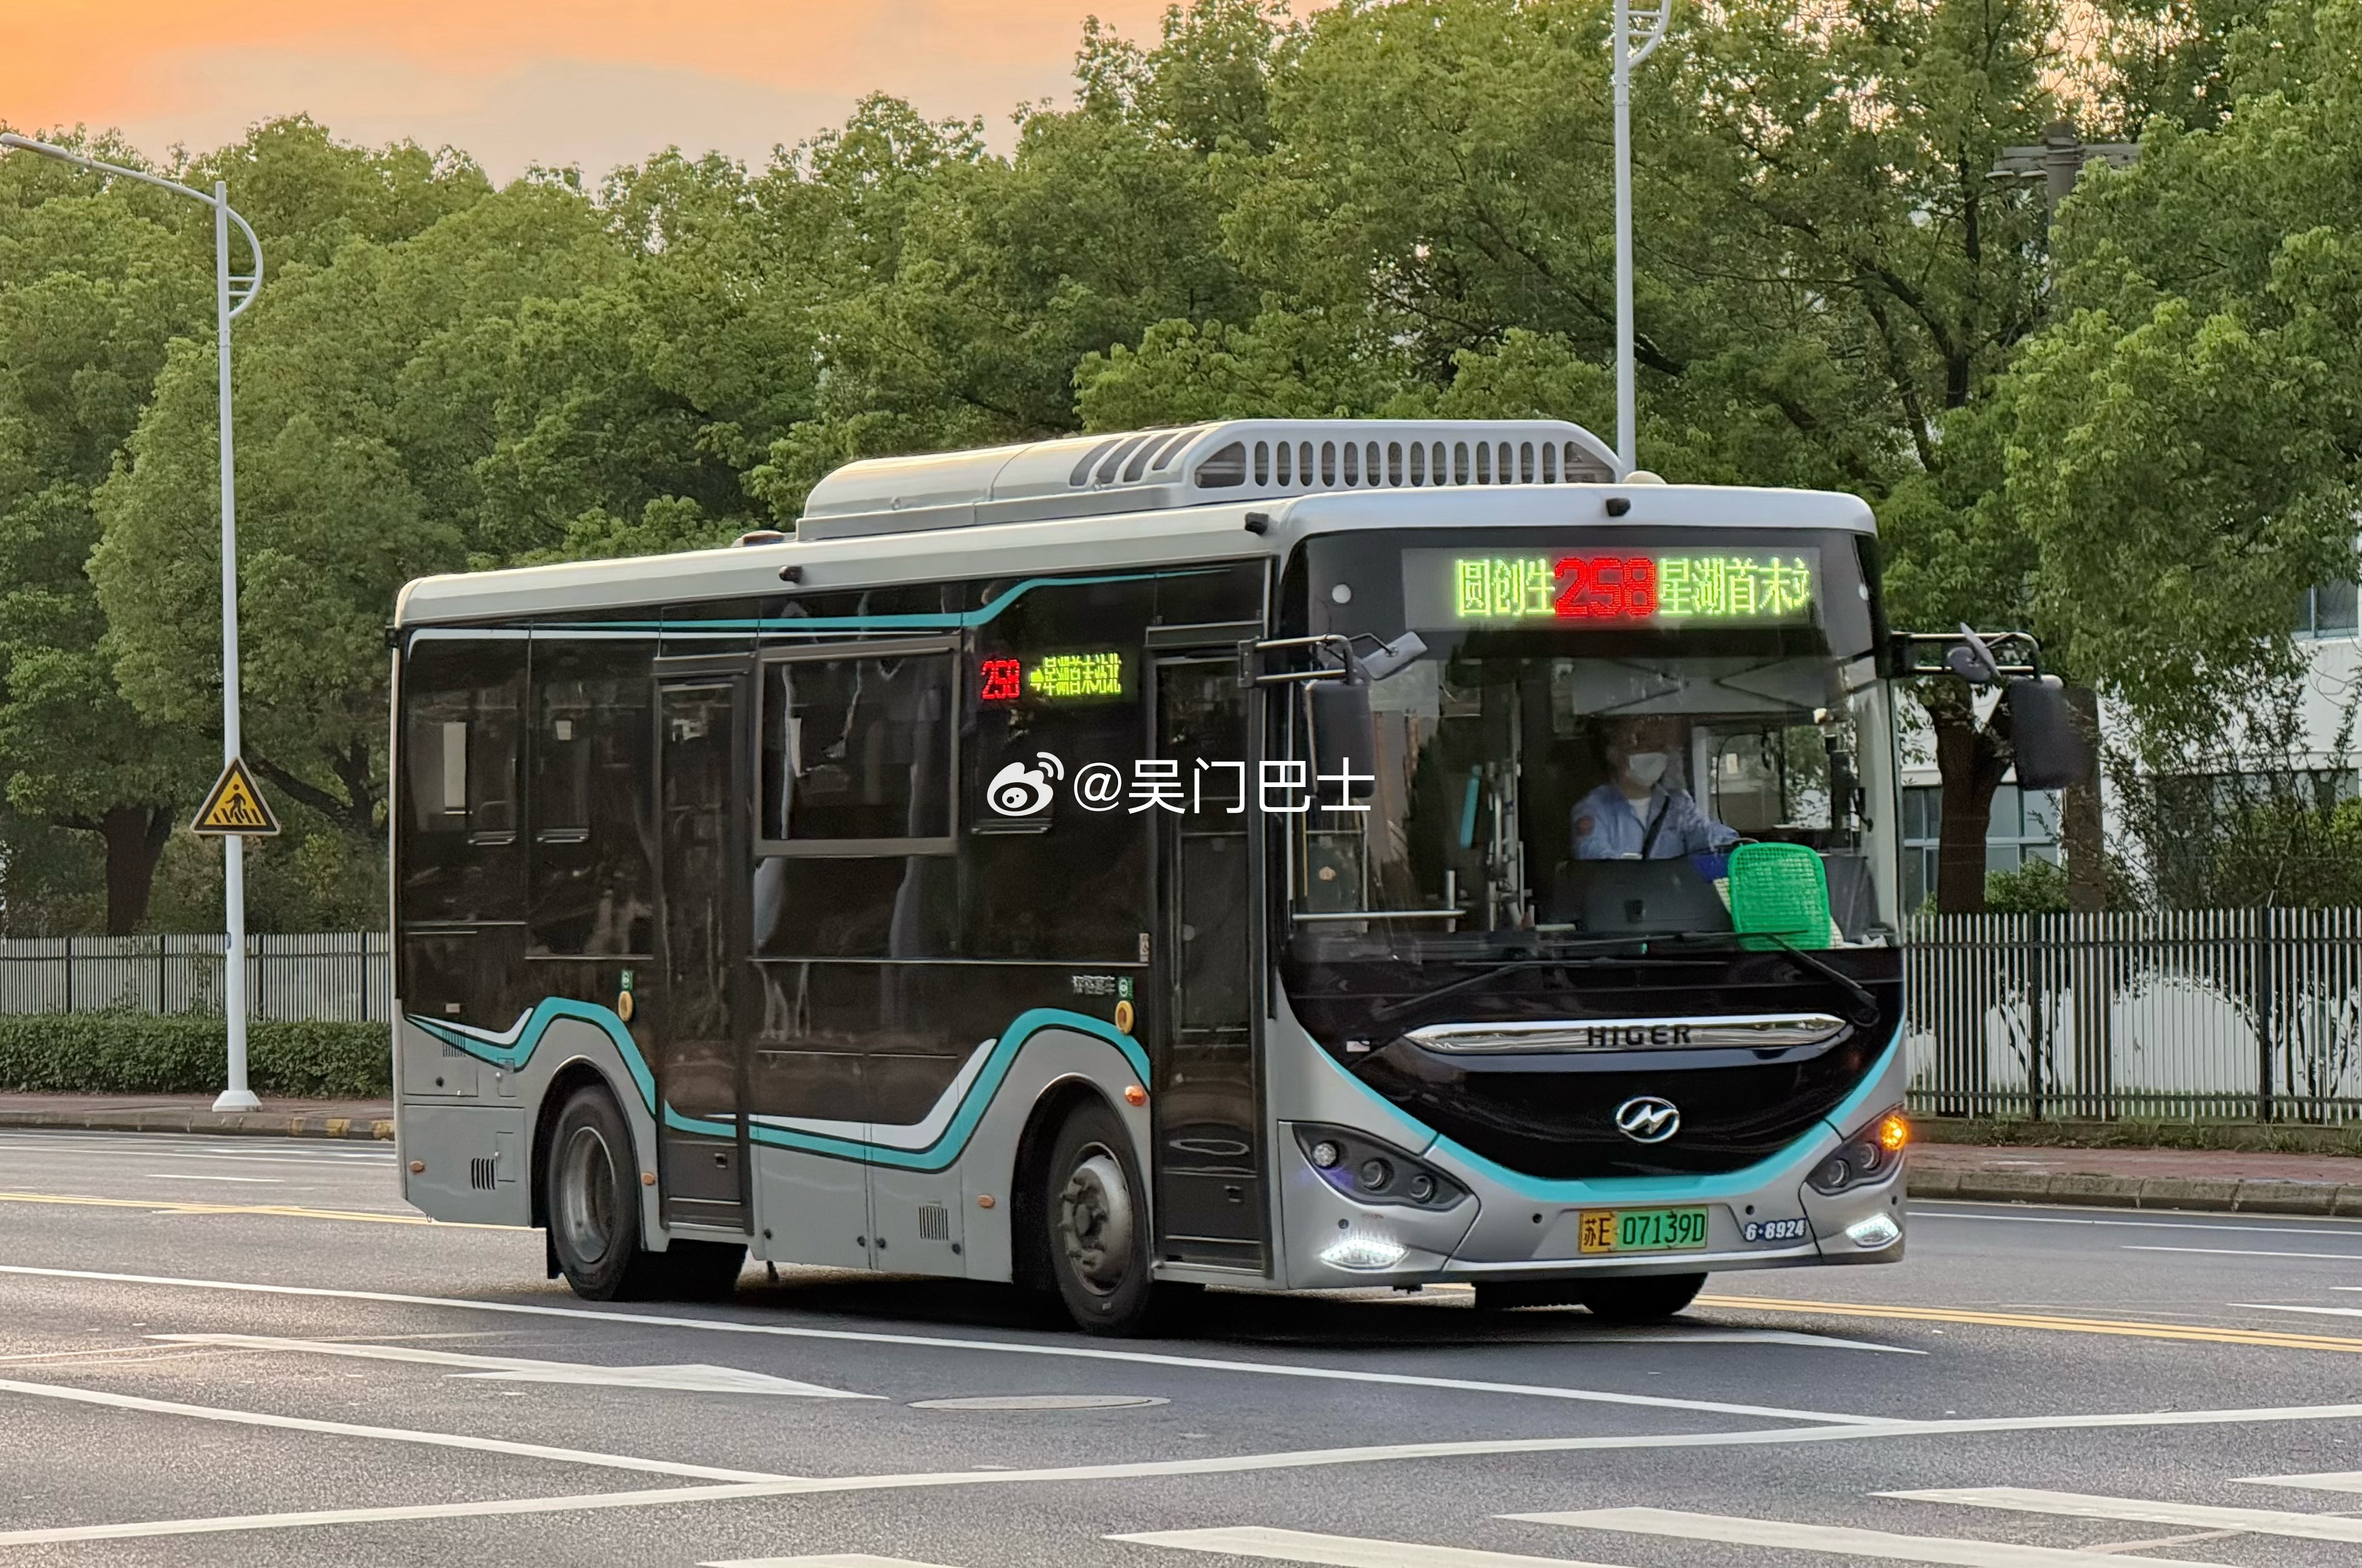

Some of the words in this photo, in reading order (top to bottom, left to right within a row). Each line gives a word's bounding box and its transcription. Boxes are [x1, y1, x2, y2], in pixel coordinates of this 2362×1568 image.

[1555, 557, 1657, 616] 258
[1588, 1024, 1691, 1046] HIGER
[1584, 1218, 1611, 1246] 苏E
[1623, 1213, 1705, 1245] 07139D
